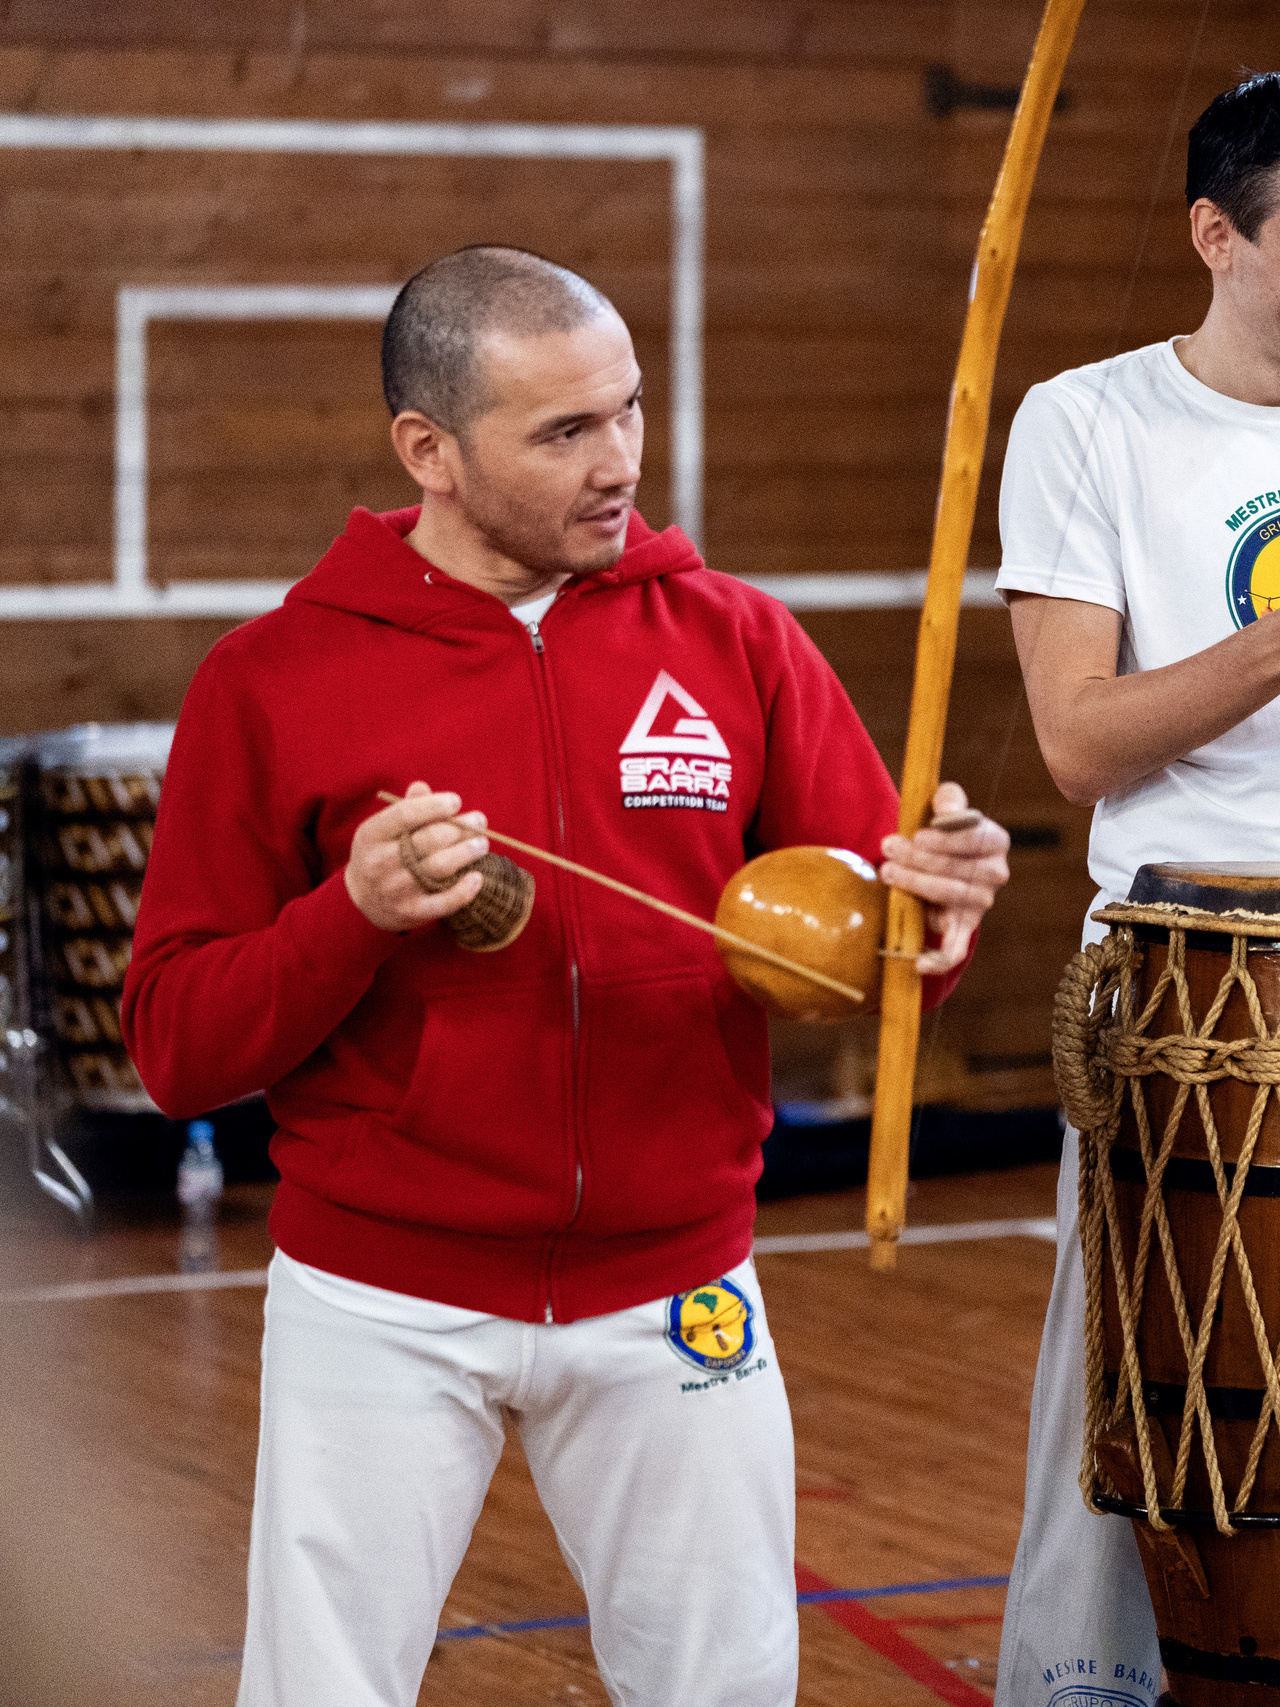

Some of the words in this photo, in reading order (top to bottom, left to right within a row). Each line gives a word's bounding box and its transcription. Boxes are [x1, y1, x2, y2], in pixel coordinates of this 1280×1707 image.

[621, 773, 730, 798] BARRA
[623, 795, 704, 809] COMPETITION
[706, 797, 728, 812] TEAM
